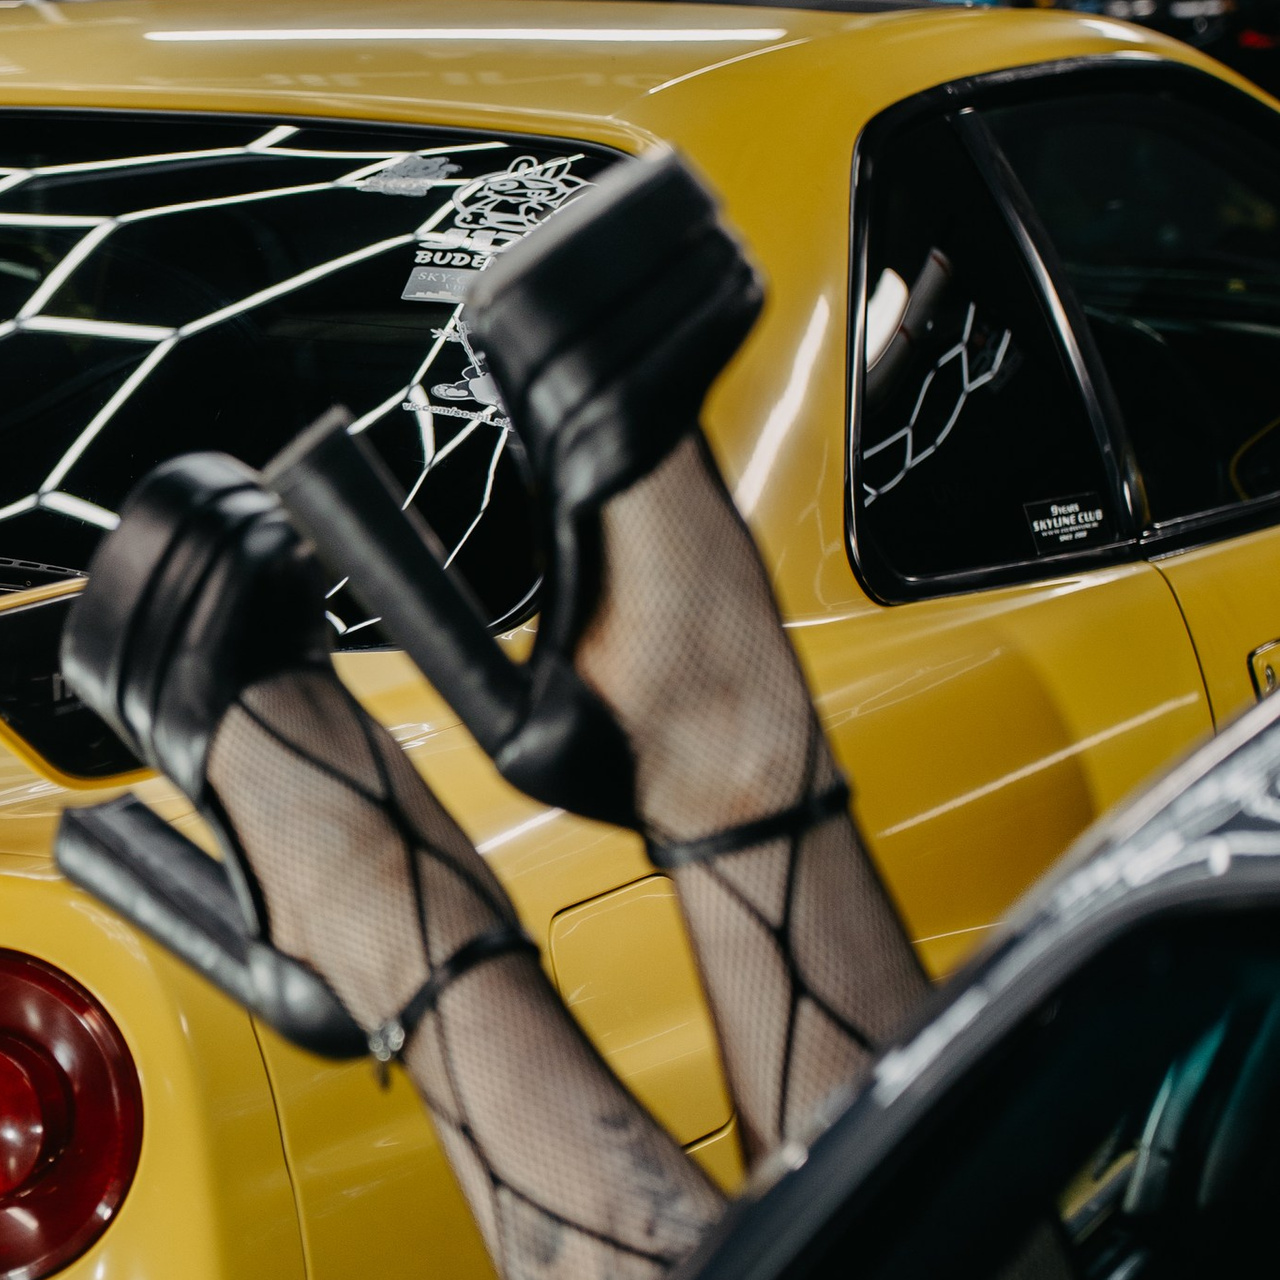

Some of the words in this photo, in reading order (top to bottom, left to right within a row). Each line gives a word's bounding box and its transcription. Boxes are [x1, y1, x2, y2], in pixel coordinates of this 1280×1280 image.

[413, 250, 495, 268] BUDE
[418, 271, 469, 284] SKY-C
[1032, 513, 1077, 532] SKYLINE
[1077, 508, 1104, 524] CLUB
